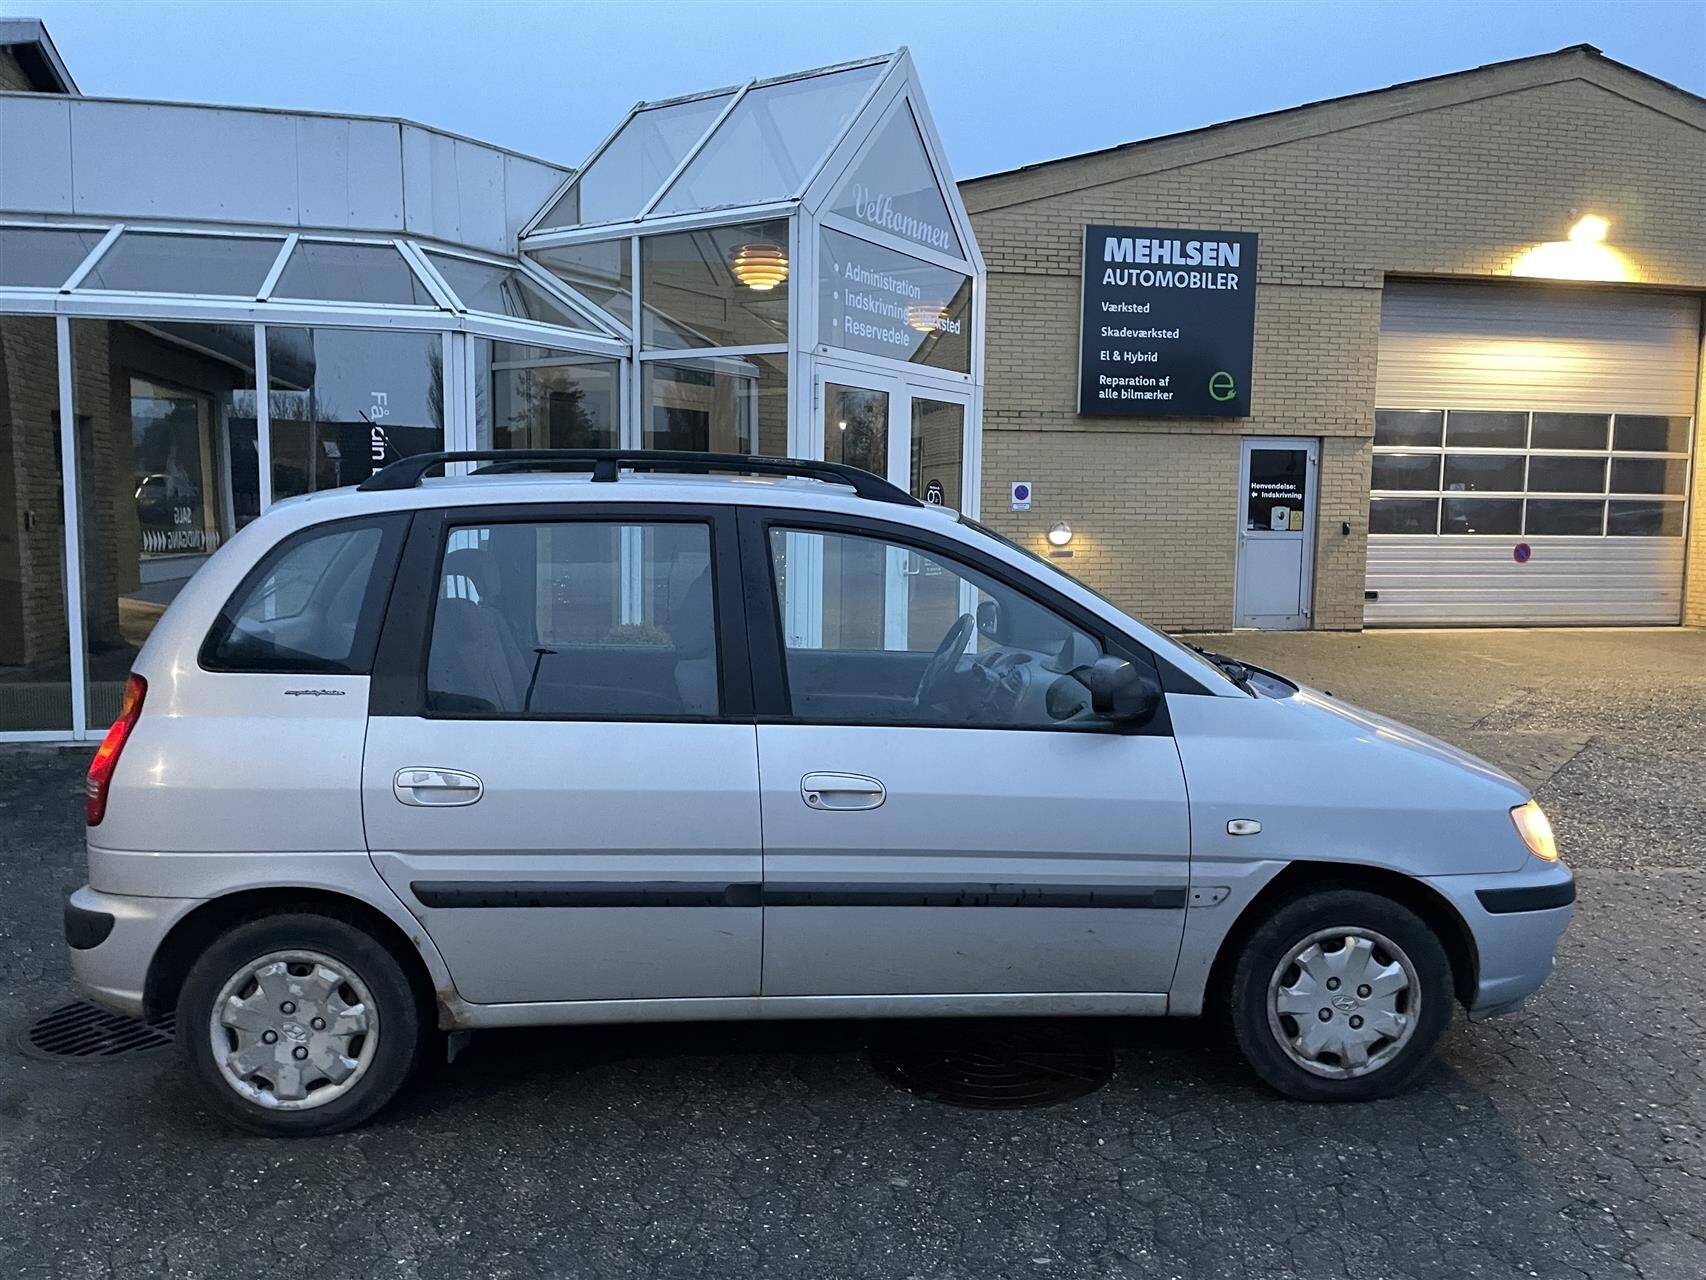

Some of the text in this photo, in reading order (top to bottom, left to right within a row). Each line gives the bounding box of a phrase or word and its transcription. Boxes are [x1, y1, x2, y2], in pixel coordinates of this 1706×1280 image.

[852, 184, 950, 249] Velkommen
[1104, 237, 1240, 267] MEHLSEN
[844, 262, 921, 299] Administration
[1102, 268, 1239, 290] AUTOMOBILER
[844, 289, 909, 326] Indskrivning
[1101, 301, 1150, 313] Værksted
[844, 316, 910, 347] Reservedele
[1101, 326, 1179, 339] Skadeværksted
[1100, 350, 1158, 364] El & Hybrid
[1099, 375, 1170, 387] Reparation af
[1098, 388, 1174, 400] alle bilmærker
[370, 391, 390, 420] Få
[1250, 482, 1296, 490] Henvendelse:
[1261, 492, 1302, 500] Indskrivning
